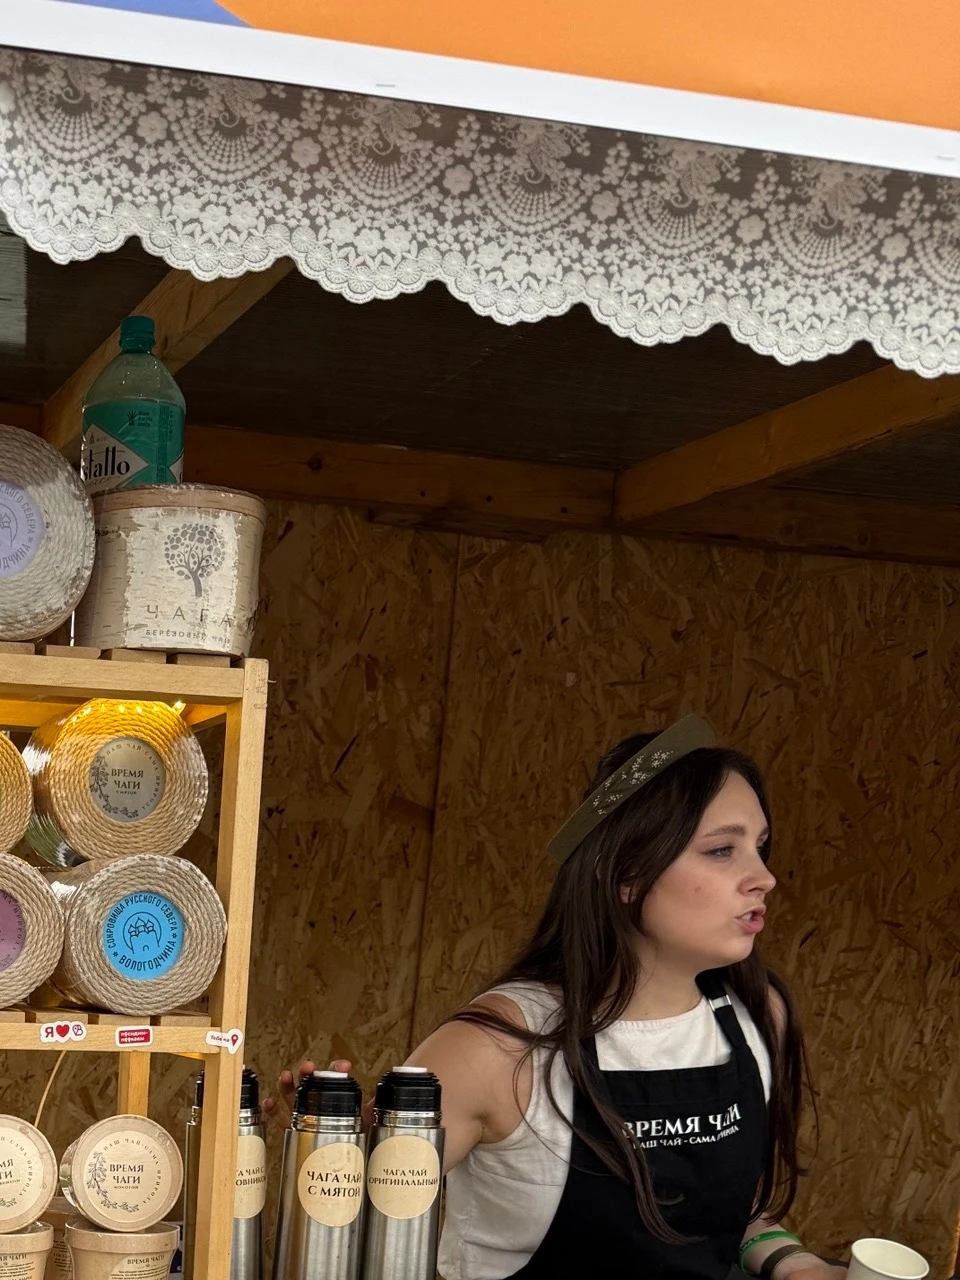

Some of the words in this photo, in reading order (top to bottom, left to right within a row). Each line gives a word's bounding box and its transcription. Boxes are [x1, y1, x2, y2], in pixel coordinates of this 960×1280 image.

[21, 501, 36, 535] СЕВЕРА
[146, 604, 233, 628] ЧАГА
[111, 768, 144, 778] ВРЕМЯ
[114, 780, 141, 790] ЧАГИ
[106, 903, 126, 949] СОКРОВИЩА
[125, 894, 162, 907] РУССКОГО
[160, 903, 178, 932] СЕВЕРА
[118, 940, 177, 972] ВОЛОГОДЧИНА
[45, 1026, 54, 1038] Я
[622, 1116, 701, 1139] ВРЕМЯ
[633, 1139, 657, 1149] АШ
[659, 1137, 682, 1147] ЧАЙ
[689, 1135, 716, 1145] САМА
[109, 1163, 144, 1173] ВРЕМЯ
[382, 1168, 407, 1178] ЧАГА
[408, 1168, 428, 1178] ЧАЙ
[112, 1175, 141, 1184] ЧАГИ
[306, 1169, 340, 1183] ЧАГА
[343, 1171, 363, 1184] ЧАЙ
[368, 1175, 440, 1187] ОРИГИНАЛЬНЫЙ
[307, 1185, 318, 1196] С
[320, 1186, 361, 1199] МЯТОЙ
[127, 1257, 150, 1265] ВРЕМЯ
